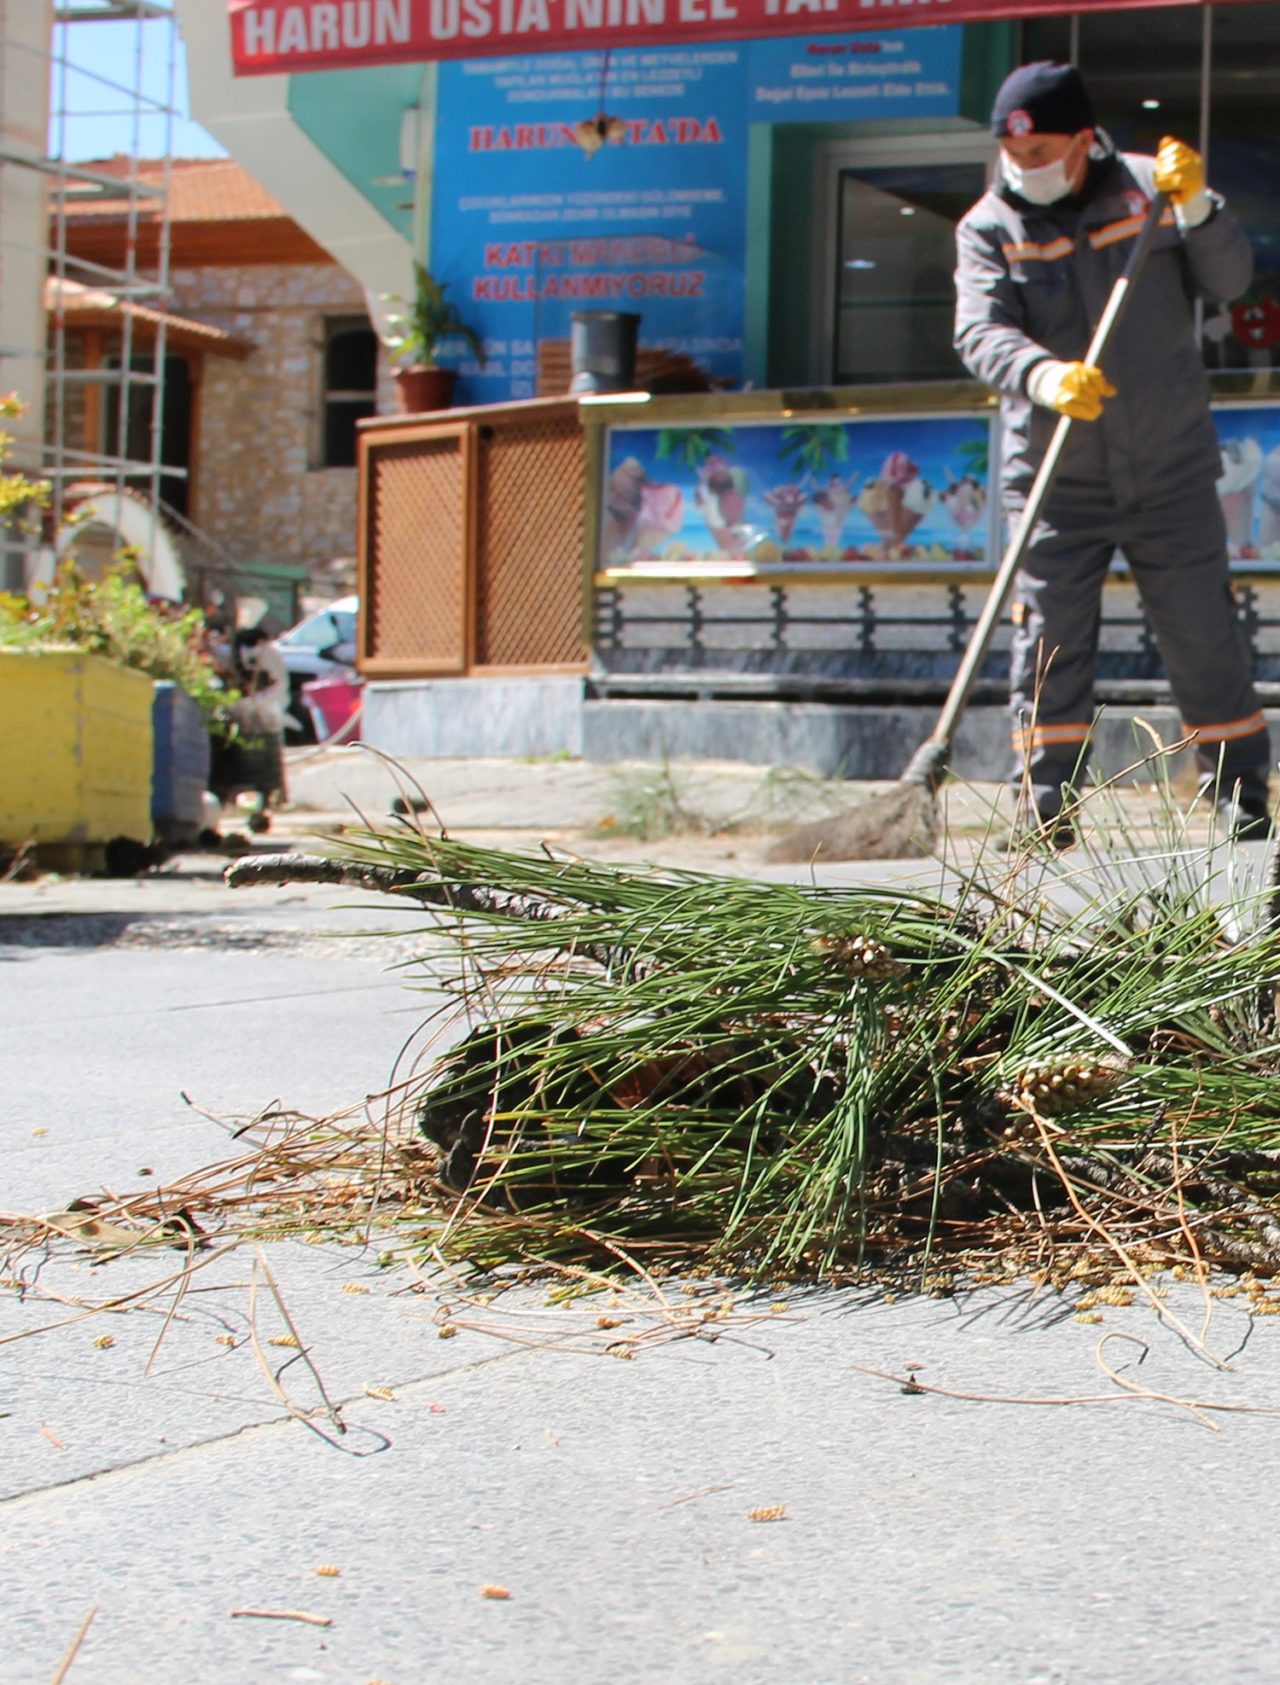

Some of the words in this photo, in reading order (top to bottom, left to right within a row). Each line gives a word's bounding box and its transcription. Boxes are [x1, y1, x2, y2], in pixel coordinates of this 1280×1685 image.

[243, 0, 411, 56] HARUN
[469, 124, 582, 151] HARUN
[473, 271, 706, 300] KULLANMIYORUZ
